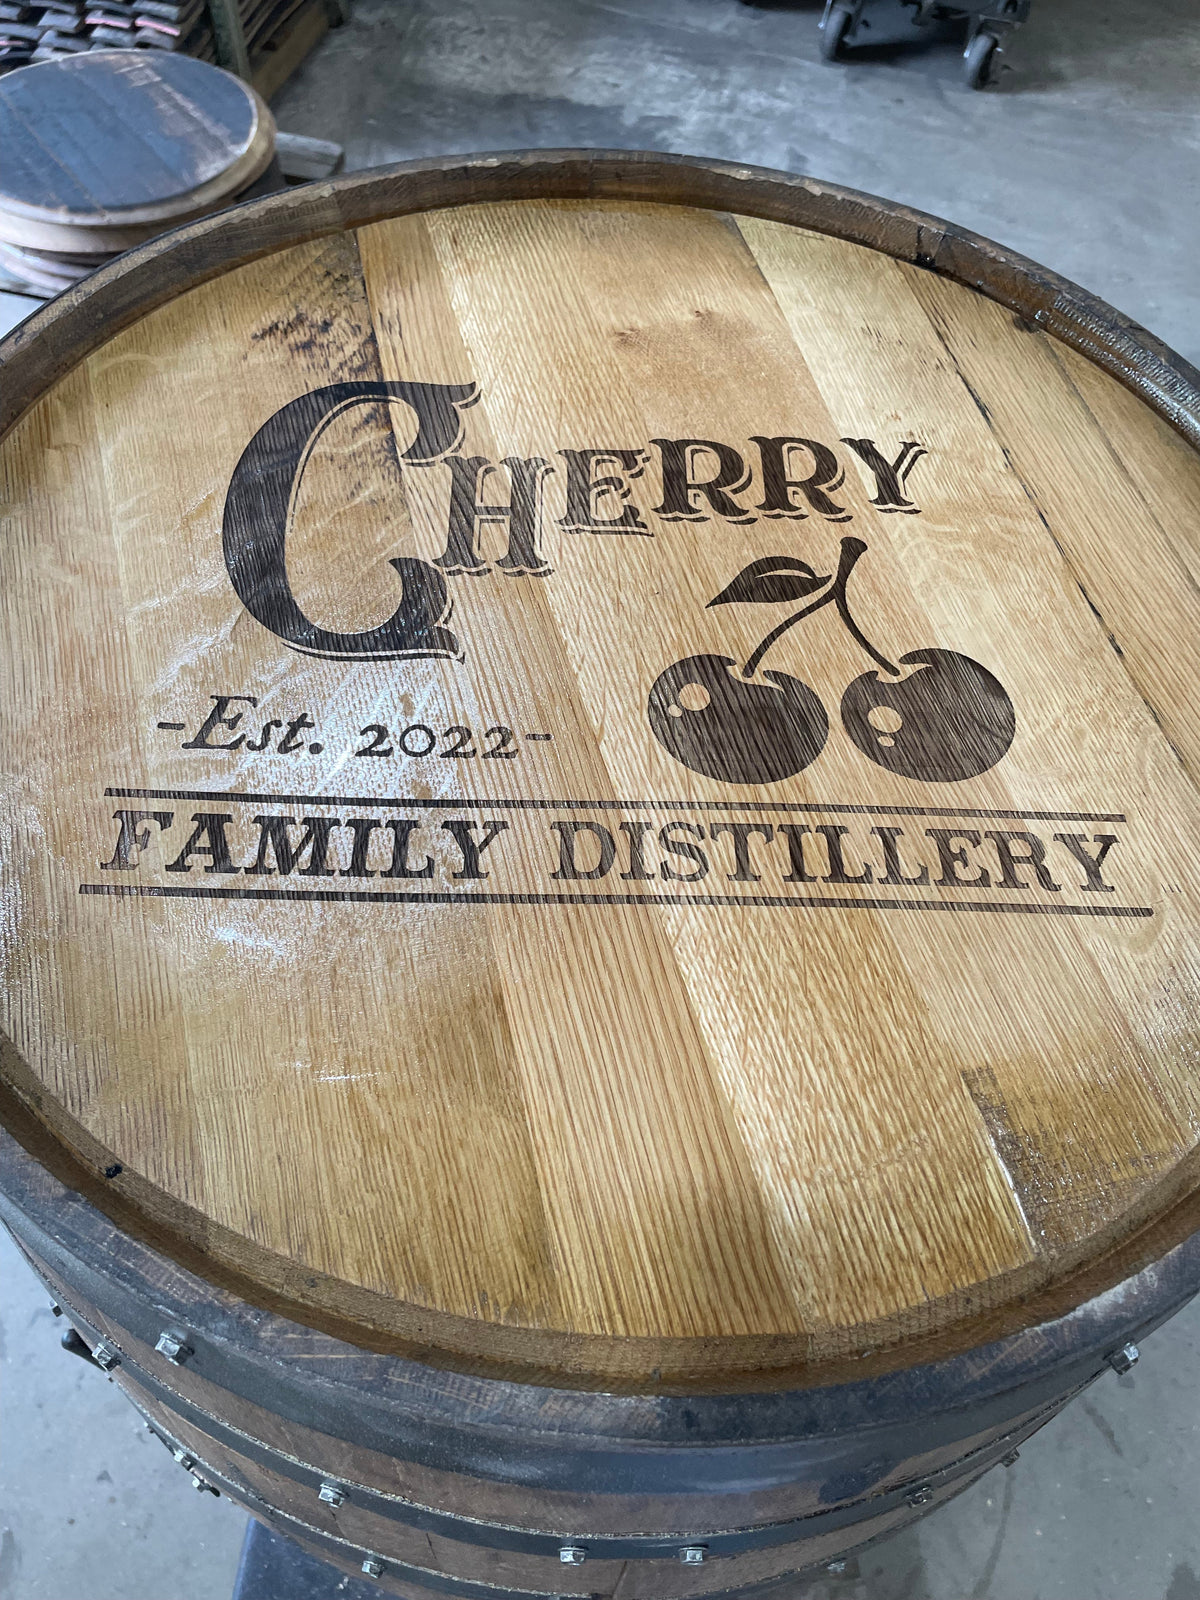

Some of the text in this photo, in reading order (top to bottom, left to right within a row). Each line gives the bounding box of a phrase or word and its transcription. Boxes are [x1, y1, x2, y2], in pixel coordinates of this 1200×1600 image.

[222, 380, 928, 664] CHERRY
[100, 809, 1120, 893] FAMILY DISTILLERY
